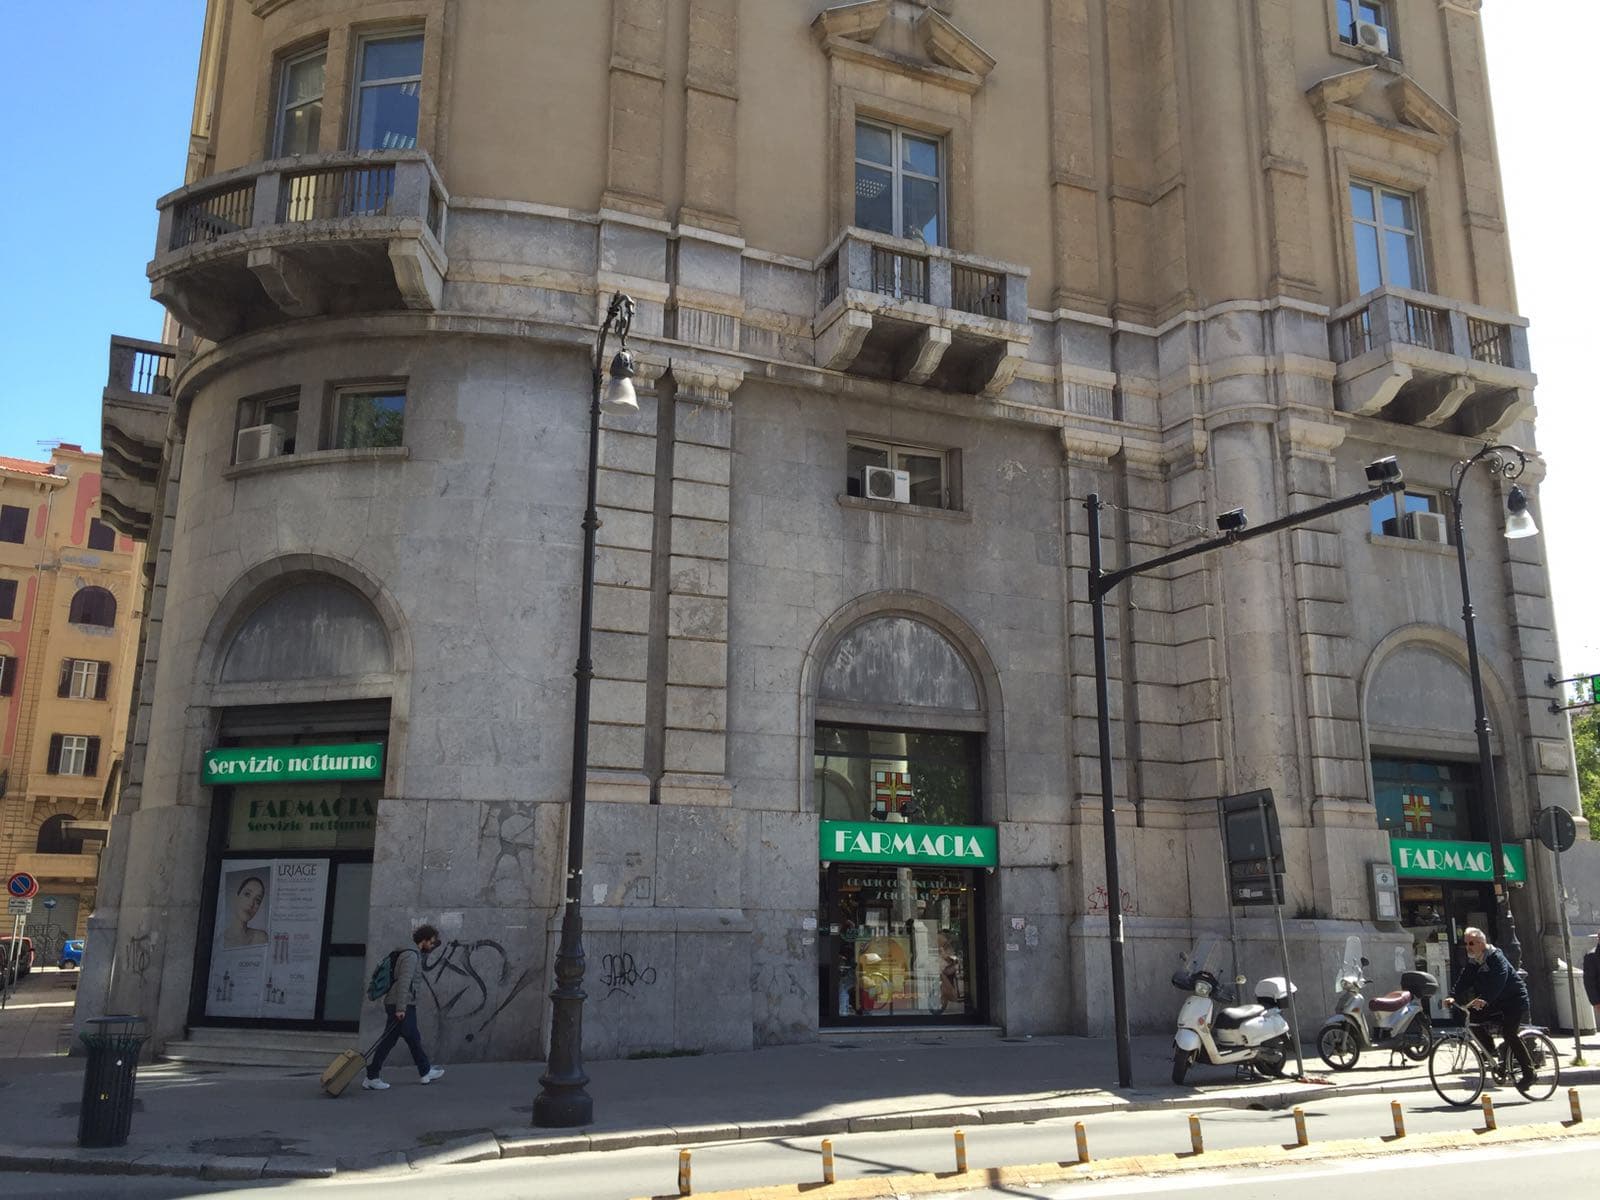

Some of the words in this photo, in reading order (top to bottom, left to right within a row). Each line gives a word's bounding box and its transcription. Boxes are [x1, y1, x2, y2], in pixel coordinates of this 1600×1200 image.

[208, 757, 284, 775] Servizio
[288, 755, 378, 772] notturno
[249, 797, 375, 818] FARMACIA
[248, 820, 301, 832] Servizio
[835, 830, 985, 858] FARMACIA
[1399, 847, 1516, 873] FARMACA
[278, 864, 318, 877] URIAGE
